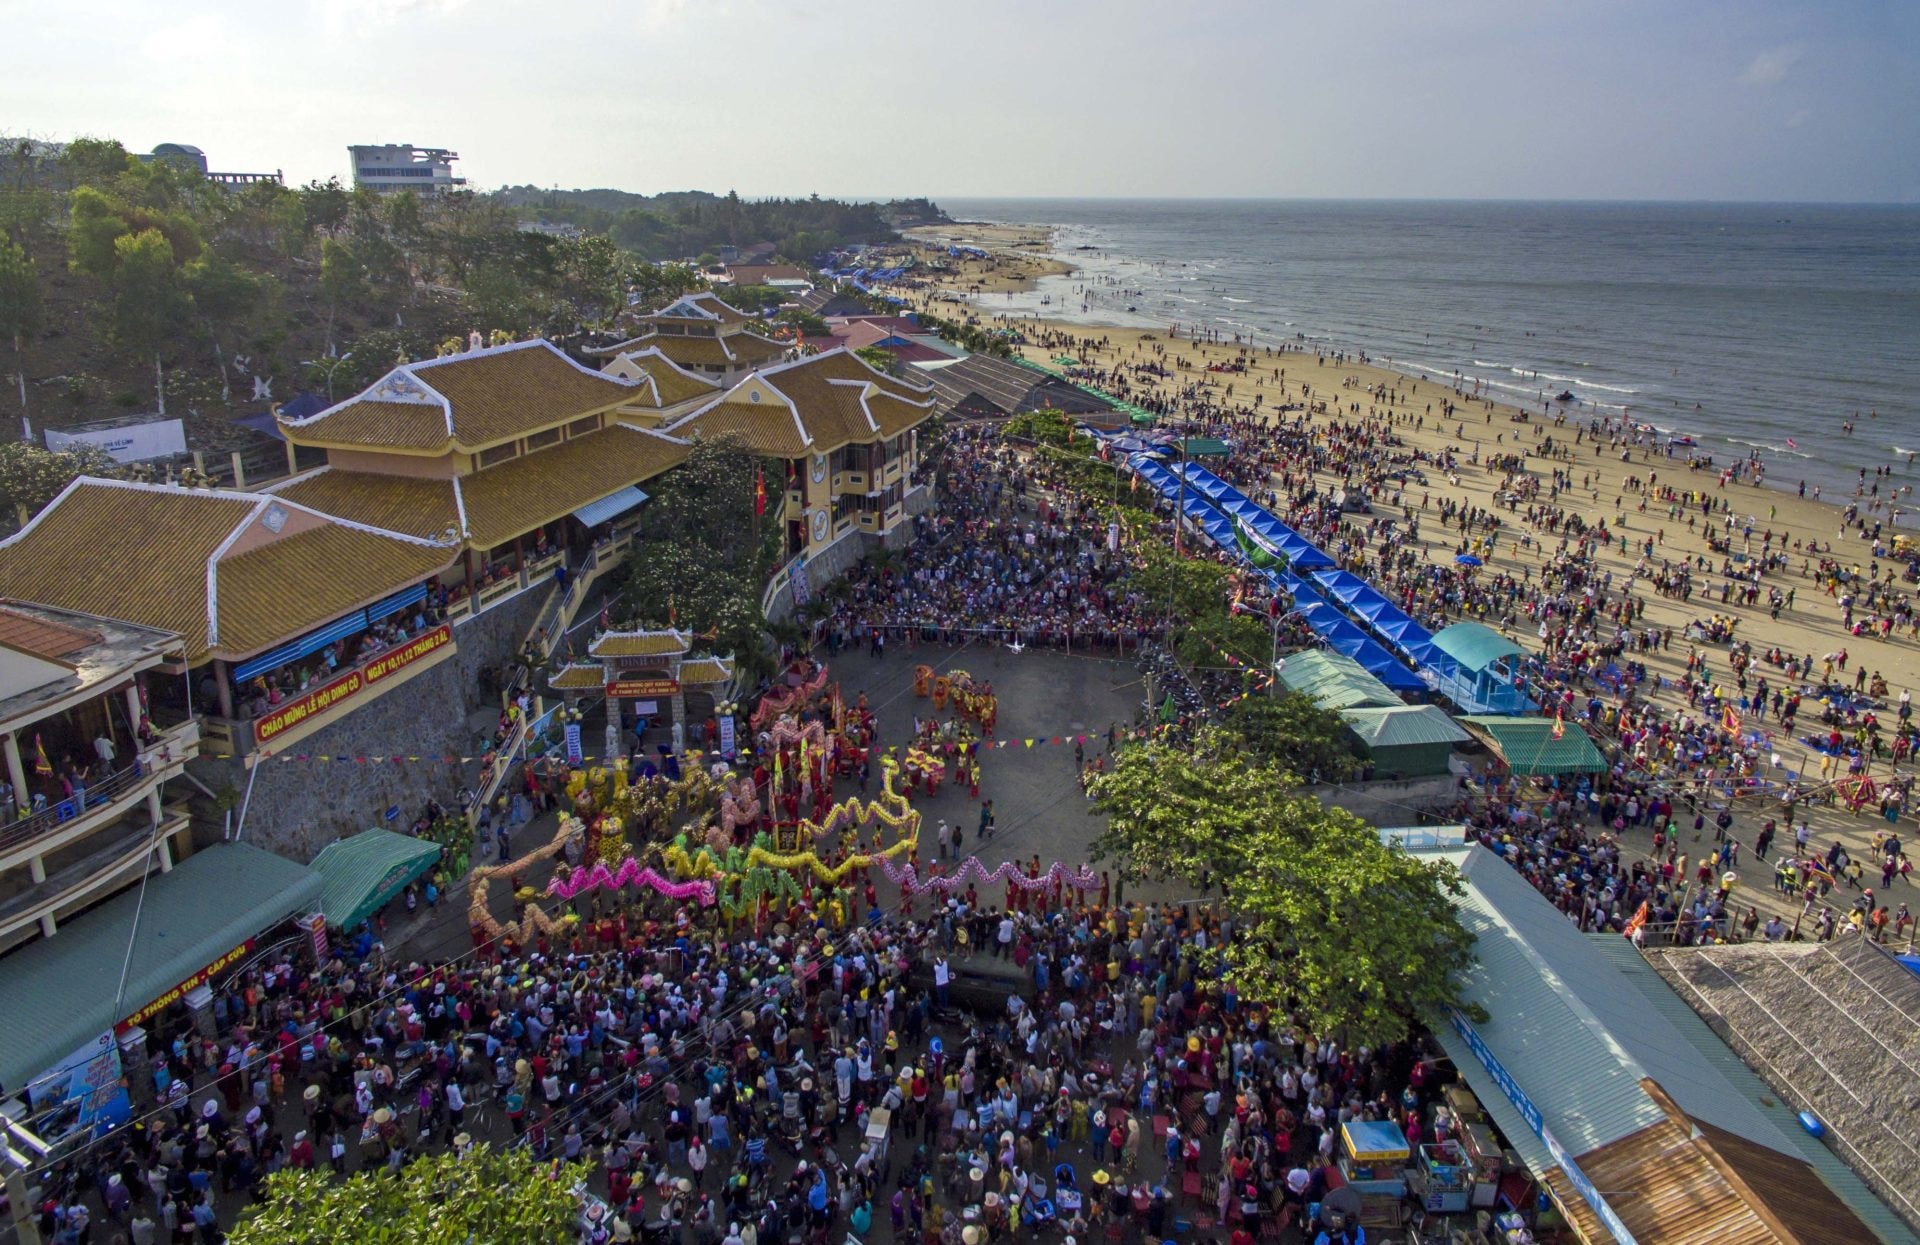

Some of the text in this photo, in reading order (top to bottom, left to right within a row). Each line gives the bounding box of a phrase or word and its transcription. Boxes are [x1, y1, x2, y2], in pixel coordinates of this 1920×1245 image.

[367, 661, 386, 681] NGÀY
[388, 648, 413, 671] 10,11,12
[413, 637, 435, 656] THÁNG
[435, 635, 439, 645] 2
[261, 715, 284, 737] CHÀO
[307, 693, 317, 713] LỄ
[317, 691, 331, 709] HỘI
[331, 684, 348, 703] DINH
[348, 674, 359, 692] CÔ
[127, 1011, 142, 1026] TỔ
[144, 989, 180, 1017] THÔNG
[181, 977, 199, 993] TIN
[207, 958, 226, 975] CẤP
[228, 945, 246, 961] CỨU
